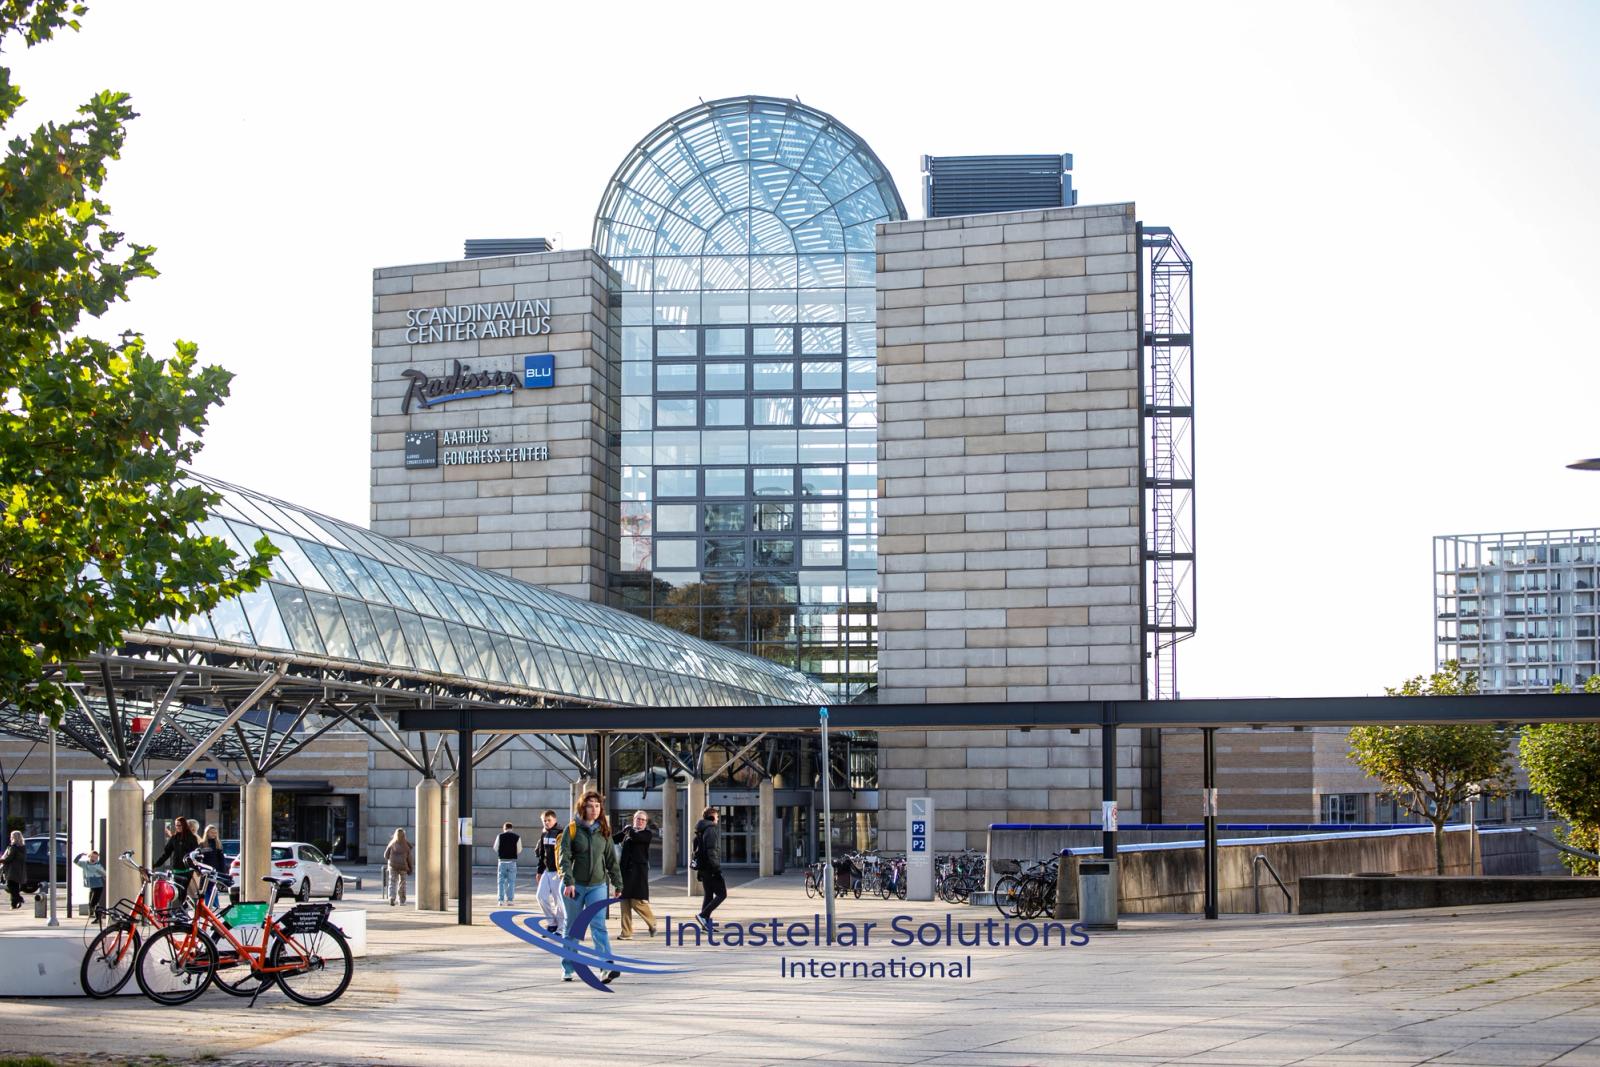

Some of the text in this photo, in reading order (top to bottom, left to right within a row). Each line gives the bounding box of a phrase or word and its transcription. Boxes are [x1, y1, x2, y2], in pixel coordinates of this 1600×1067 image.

[405, 298, 551, 327] SCANDINAVIAN
[405, 322, 478, 344] CENTER
[401, 359, 551, 415] Radisson BLU
[443, 428, 490, 446] AARHUS
[443, 446, 548, 466] CONGRESS CENTER
[913, 823, 925, 833] P3
[913, 840, 925, 849] P2
